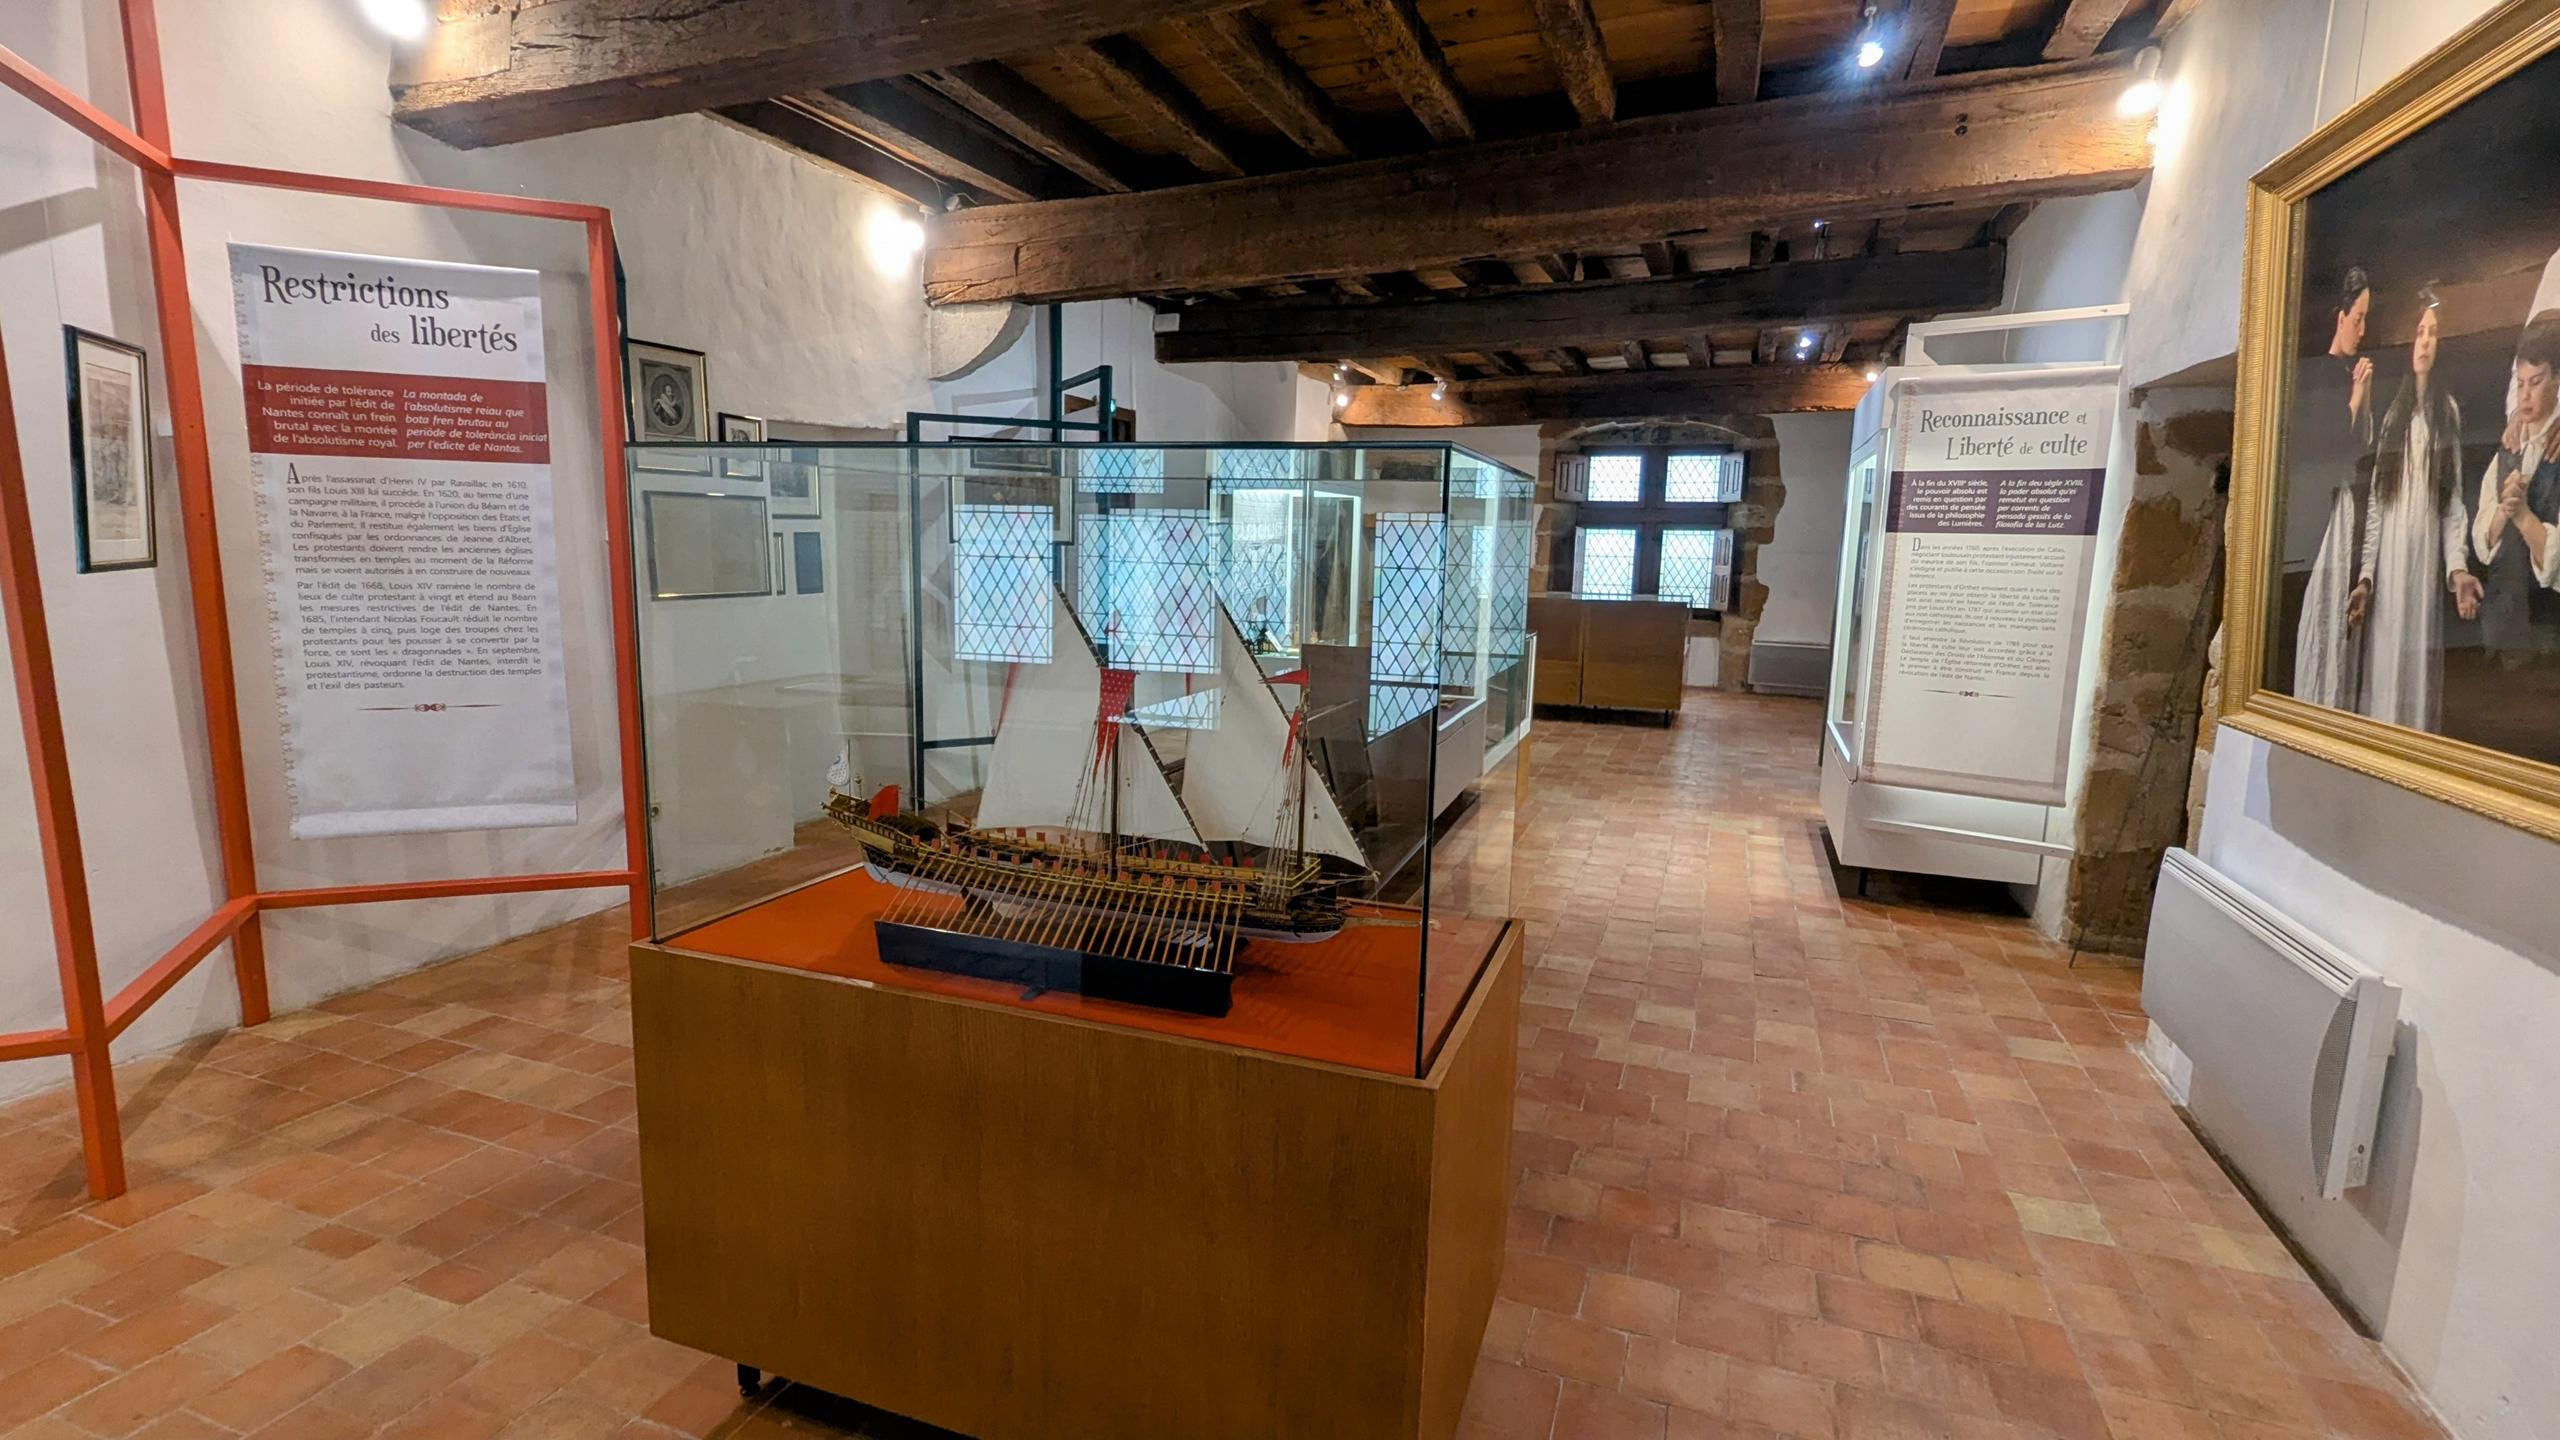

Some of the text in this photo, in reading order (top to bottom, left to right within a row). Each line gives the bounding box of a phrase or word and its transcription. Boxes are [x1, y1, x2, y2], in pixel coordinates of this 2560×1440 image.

[260, 265, 450, 310] Restrictions
[371, 314, 518, 354] des libertés
[257, 380, 394, 398] La période de tolérance
[403, 389, 484, 402] La montada de
[290, 395, 395, 410] initiée par l'édit de
[262, 406, 396, 422] Nantes connaît un frein
[404, 402, 472, 414] l'absolutisme
[506, 409, 525, 418] que
[405, 415, 429, 424] bota
[433, 416, 454, 426] fren
[458, 417, 491, 427] brutau
[1920, 407, 2087, 433] Reconnaissance et
[274, 421, 398, 435] brutal avec la montée
[449, 429, 462, 438] de
[273, 434, 398, 449] de l'absolutisme royal.
[408, 441, 424, 450] per
[468, 442, 481, 451] de
[1946, 433, 2088, 460] Liberté de culte
[1945, 512, 1985, 520] philosophie
[297, 581, 313, 589] Par
[319, 627, 357, 635] temples
[397, 626, 416, 634] puis
[421, 627, 440, 635] loge
[465, 626, 499, 634] troupes
[527, 625, 538, 633] les
[425, 669, 432, 677] la
